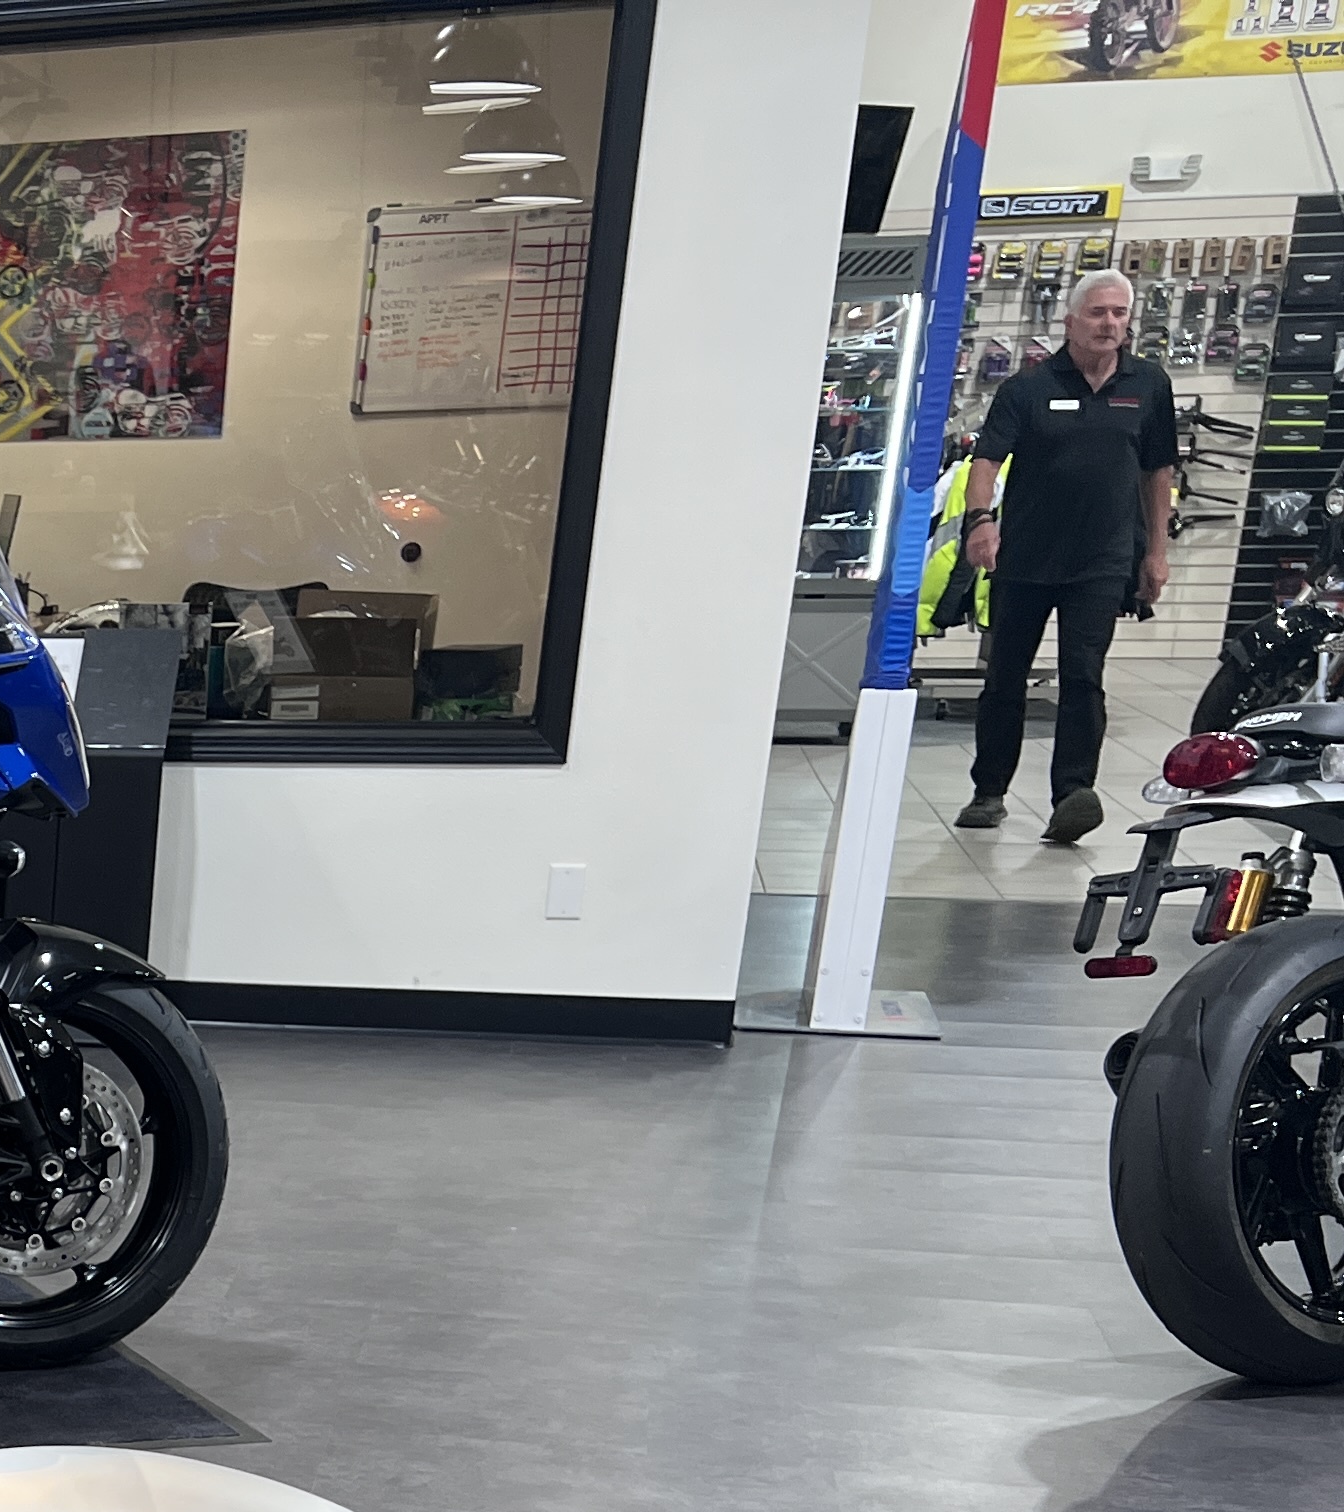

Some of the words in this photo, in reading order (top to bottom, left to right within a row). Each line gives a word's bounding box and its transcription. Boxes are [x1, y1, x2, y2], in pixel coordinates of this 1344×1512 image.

[1287, 41, 1344, 58] SUZ
[1011, 194, 1098, 214] SCOTT
[419, 213, 450, 224] APPT
